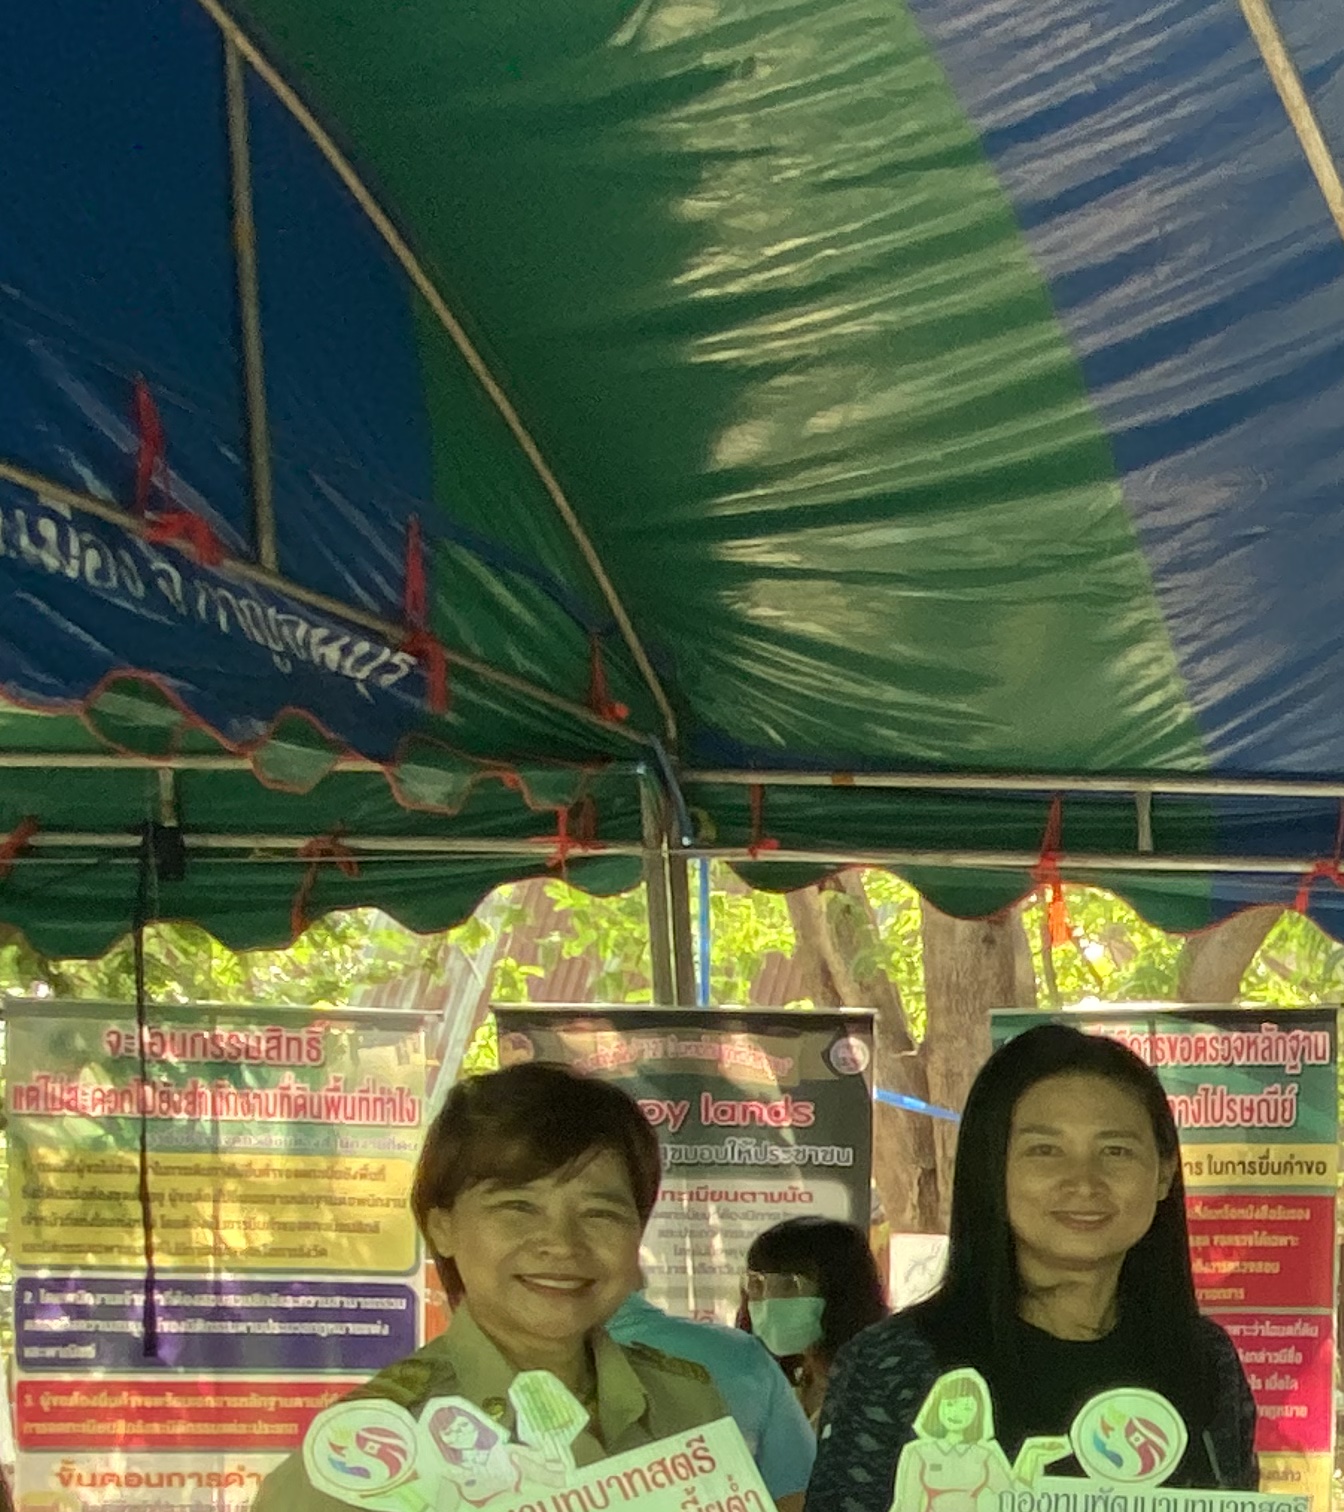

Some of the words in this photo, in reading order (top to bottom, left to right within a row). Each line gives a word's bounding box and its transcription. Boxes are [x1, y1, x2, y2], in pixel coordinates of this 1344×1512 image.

[701, 1092, 816, 1127] lands
[659, 1136, 852, 1167] ุขมอบให้ประชาชน
[1207, 1152, 1328, 1177] ในการยื่นคำขอ
